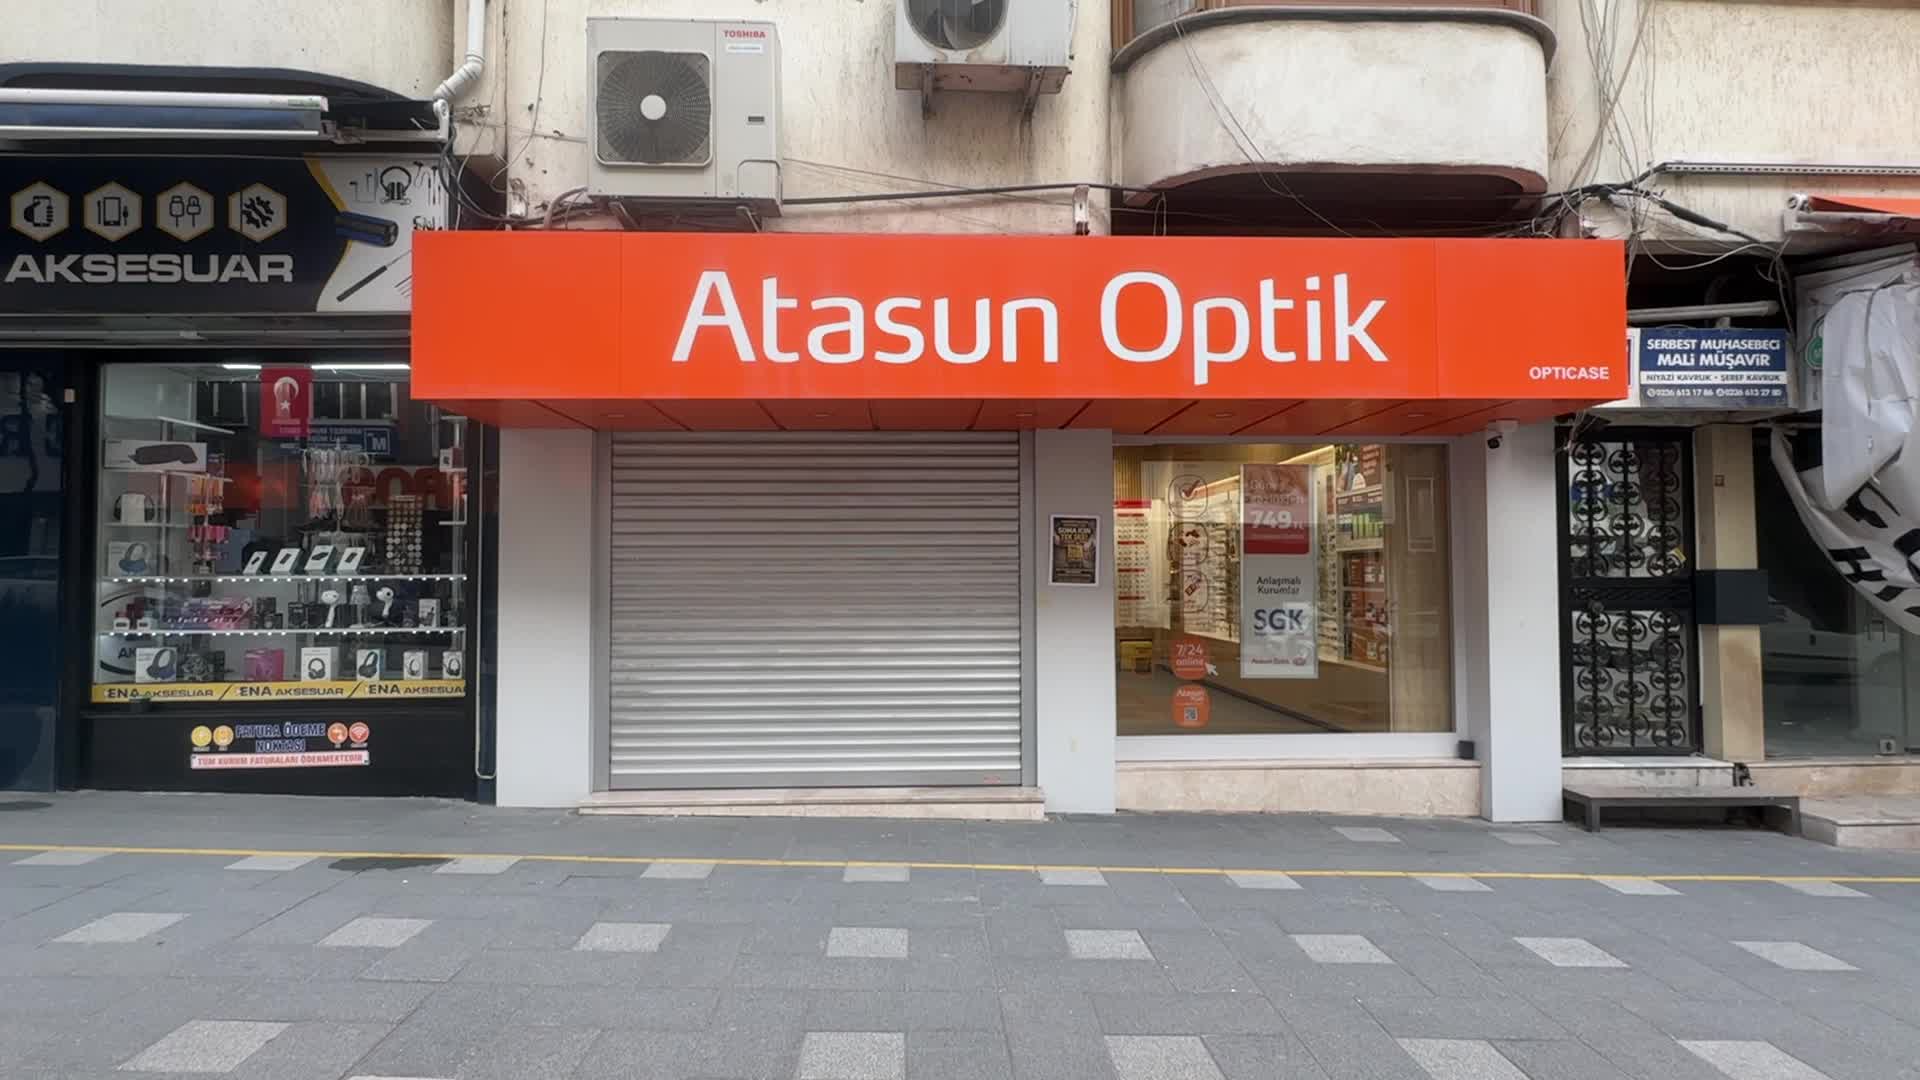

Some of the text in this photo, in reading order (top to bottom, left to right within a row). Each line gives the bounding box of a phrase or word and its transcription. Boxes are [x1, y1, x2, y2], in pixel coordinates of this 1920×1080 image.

[724, 30, 766, 38] TOSHIBA
[5, 255, 293, 283] AKSESUAR
[672, 271, 1388, 386] Atasun Optik
[1647, 339, 1697, 350] SERBEST
[1657, 350, 1771, 370] MALİ MÜŞAVİR
[1529, 366, 1609, 380] OPTICASE
[1250, 510, 1292, 529] 749
[1256, 576, 1302, 587] Anlaşmalı
[1257, 586, 1300, 595] Kurumlar
[1253, 608, 1304, 631] SGK
[1176, 644, 1204, 657] 7/24
[107, 688, 139, 698] ENA
[240, 685, 272, 697] ENA
[275, 687, 344, 696] AKSESUAR
[368, 684, 400, 695] ENA
[404, 686, 465, 695] AKSESUA
[235, 721, 326, 738] FATURA ÖDEME
[255, 738, 306, 753] NOKTASI
